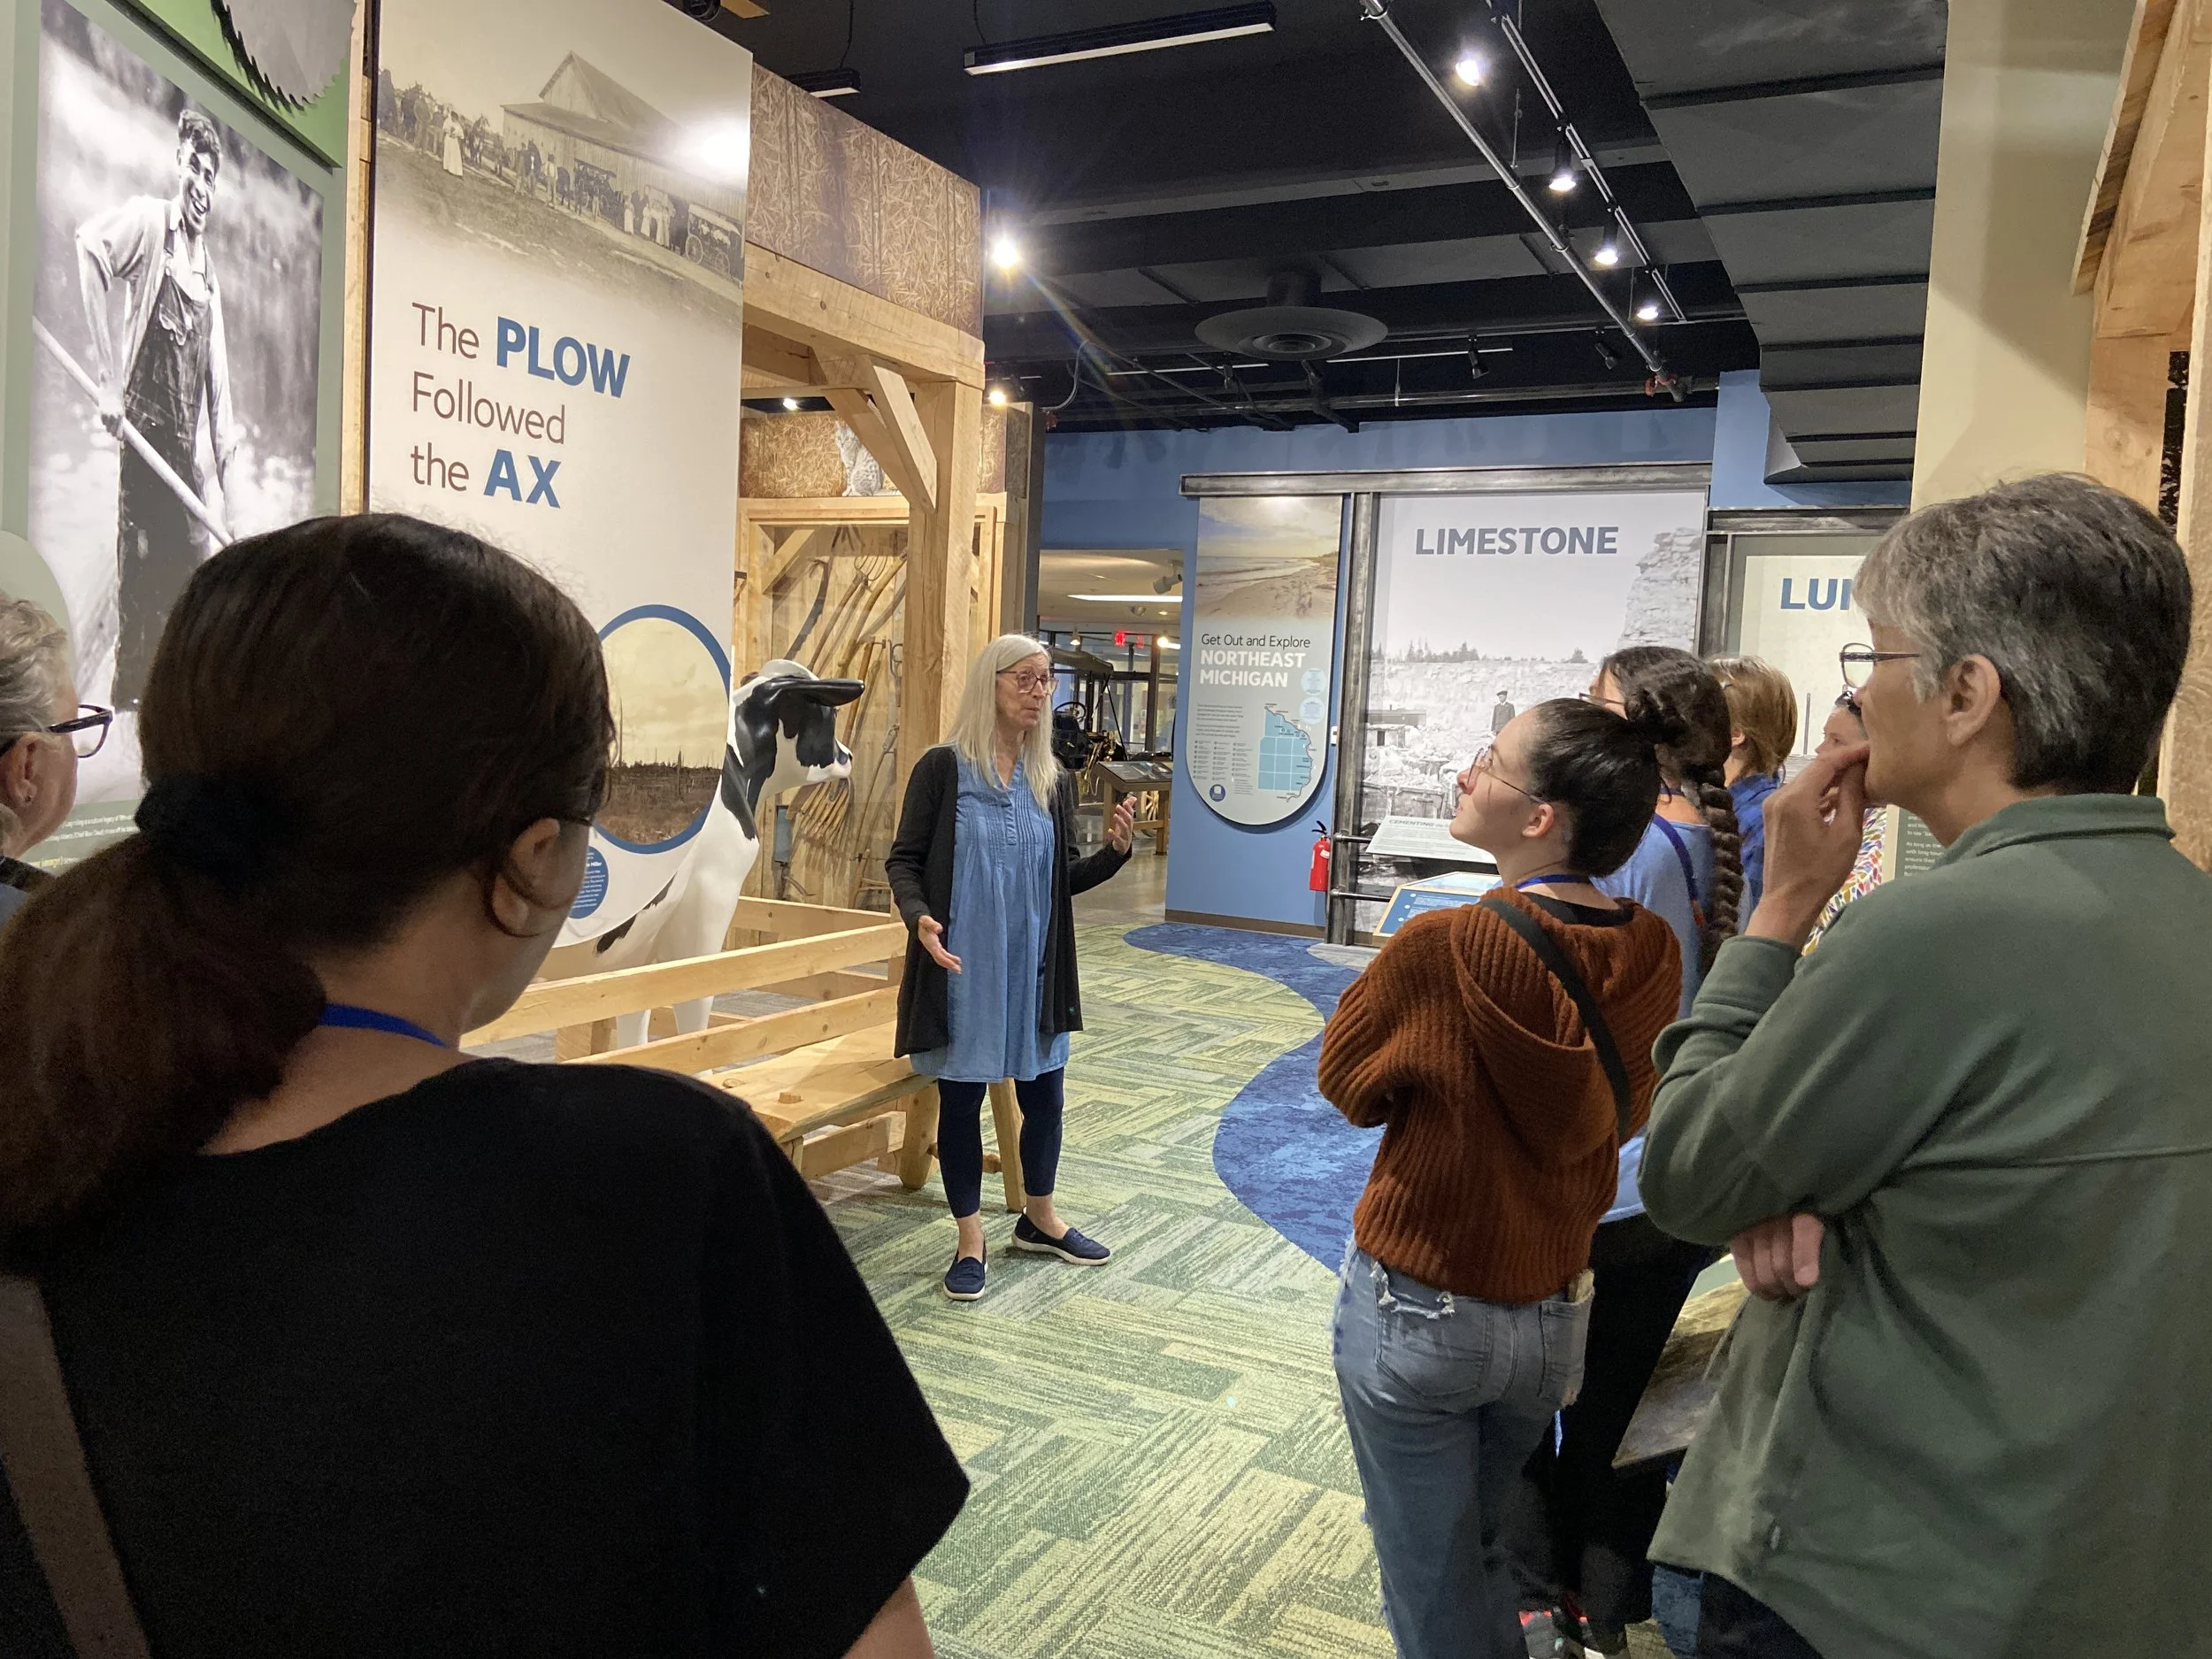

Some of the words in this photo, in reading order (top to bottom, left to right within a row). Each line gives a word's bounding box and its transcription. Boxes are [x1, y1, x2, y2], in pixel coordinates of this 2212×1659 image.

[411, 302, 480, 359] The
[496, 316, 631, 398] PLOW
[412, 371, 565, 445] Followed
[411, 442, 470, 491] the
[483, 449, 562, 509] AX
[1415, 526, 1619, 555] LIMESTONE
[1201, 634, 1221, 645] Get
[1224, 634, 1244, 646] Out
[1246, 635, 1266, 647] and
[1269, 635, 1310, 650] Explore
[1201, 649, 1307, 668] NORTHEAST
[1200, 669, 1289, 687] MICHIGAN
